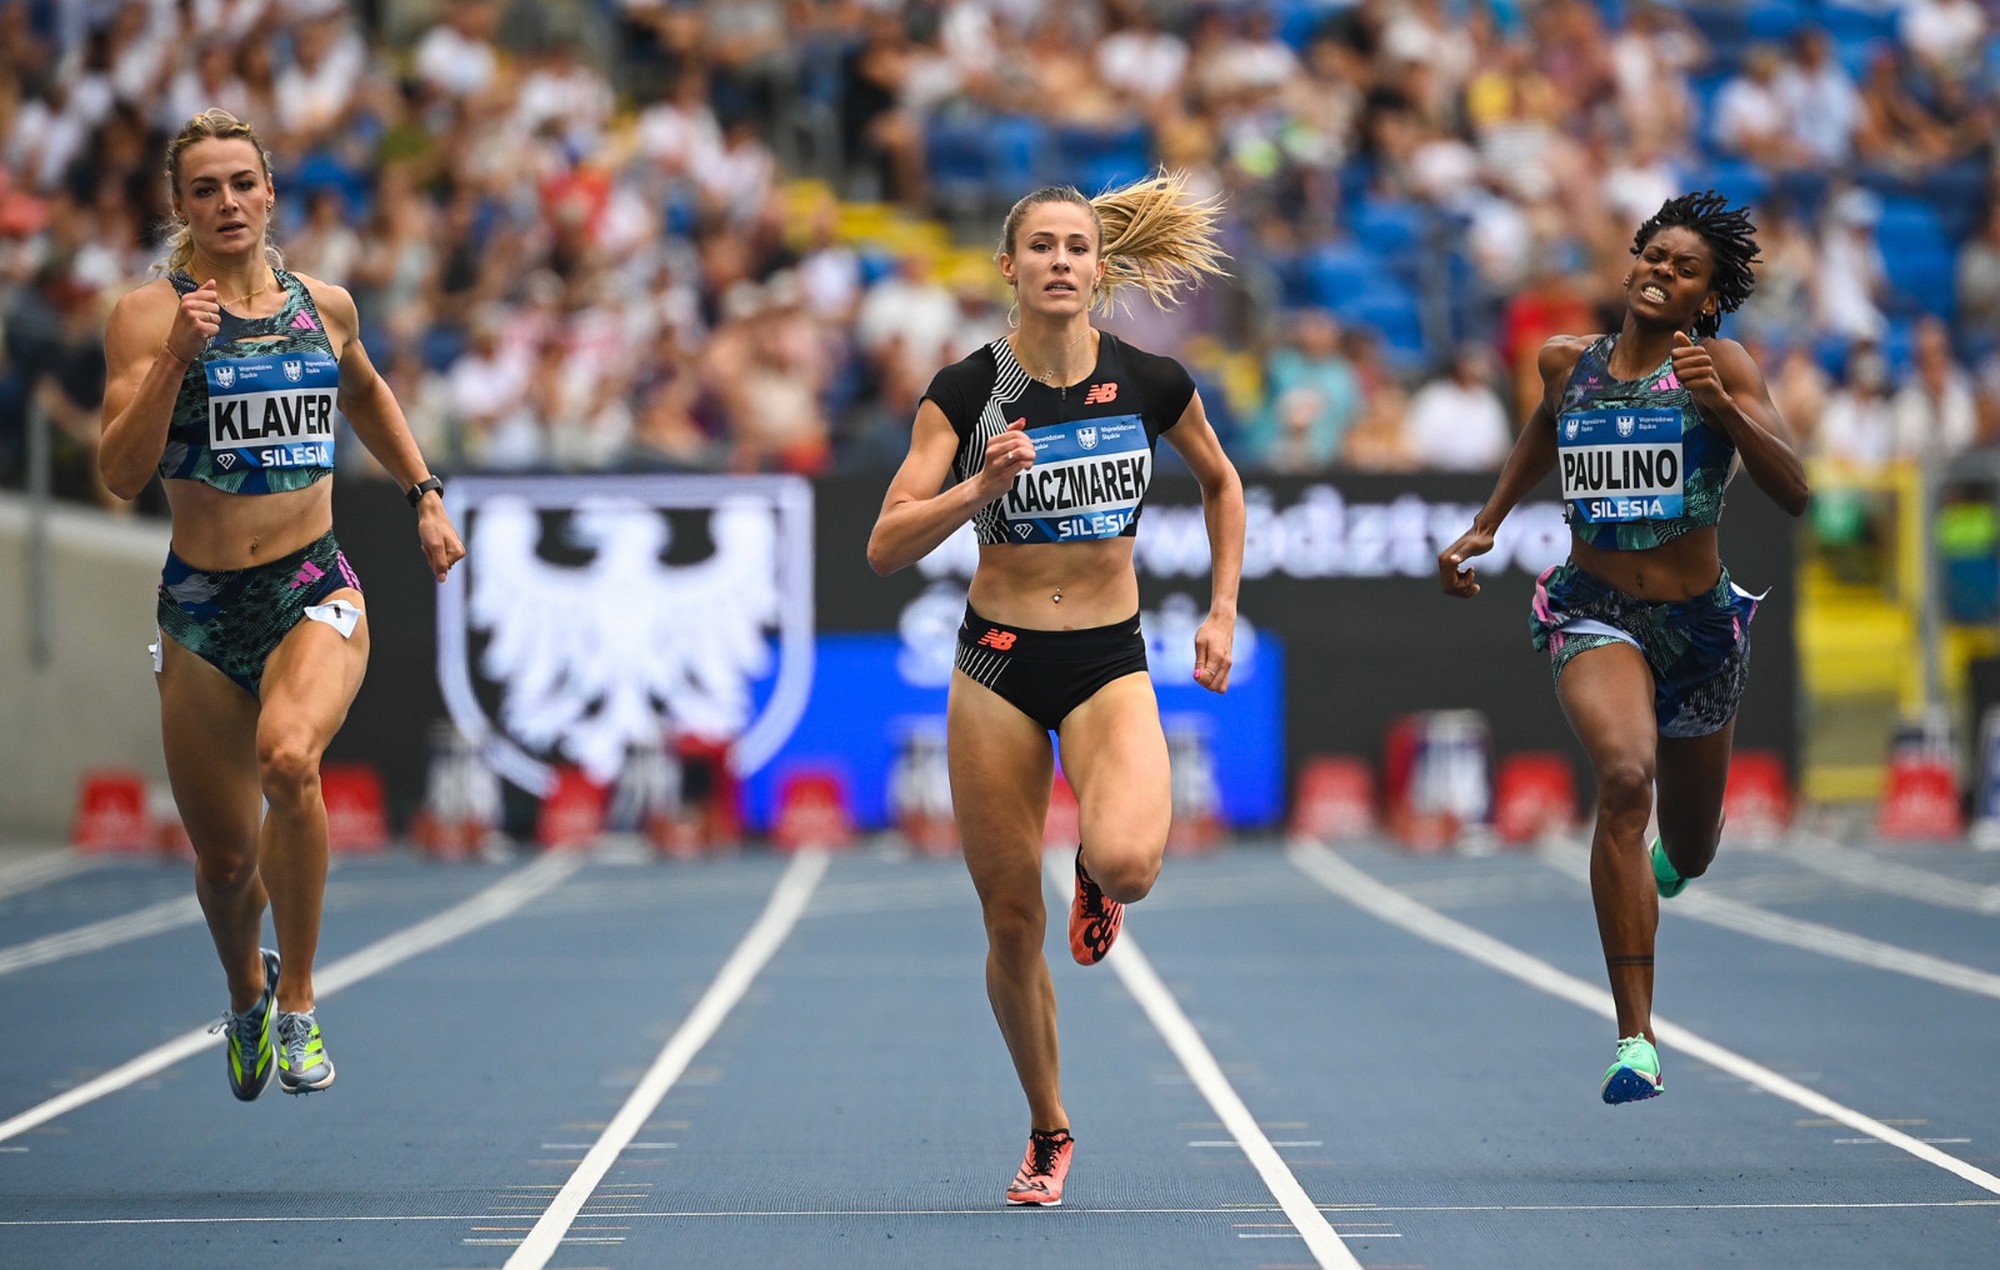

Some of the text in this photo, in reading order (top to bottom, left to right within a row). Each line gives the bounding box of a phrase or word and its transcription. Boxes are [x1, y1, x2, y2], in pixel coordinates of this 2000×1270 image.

[214, 394, 332, 442] KLAVER
[261, 446, 330, 467] SILESIA
[1563, 449, 1678, 492] PAULINO
[1008, 456, 1146, 513] KACZMAREK
[1591, 500, 1664, 518] SILESIA
